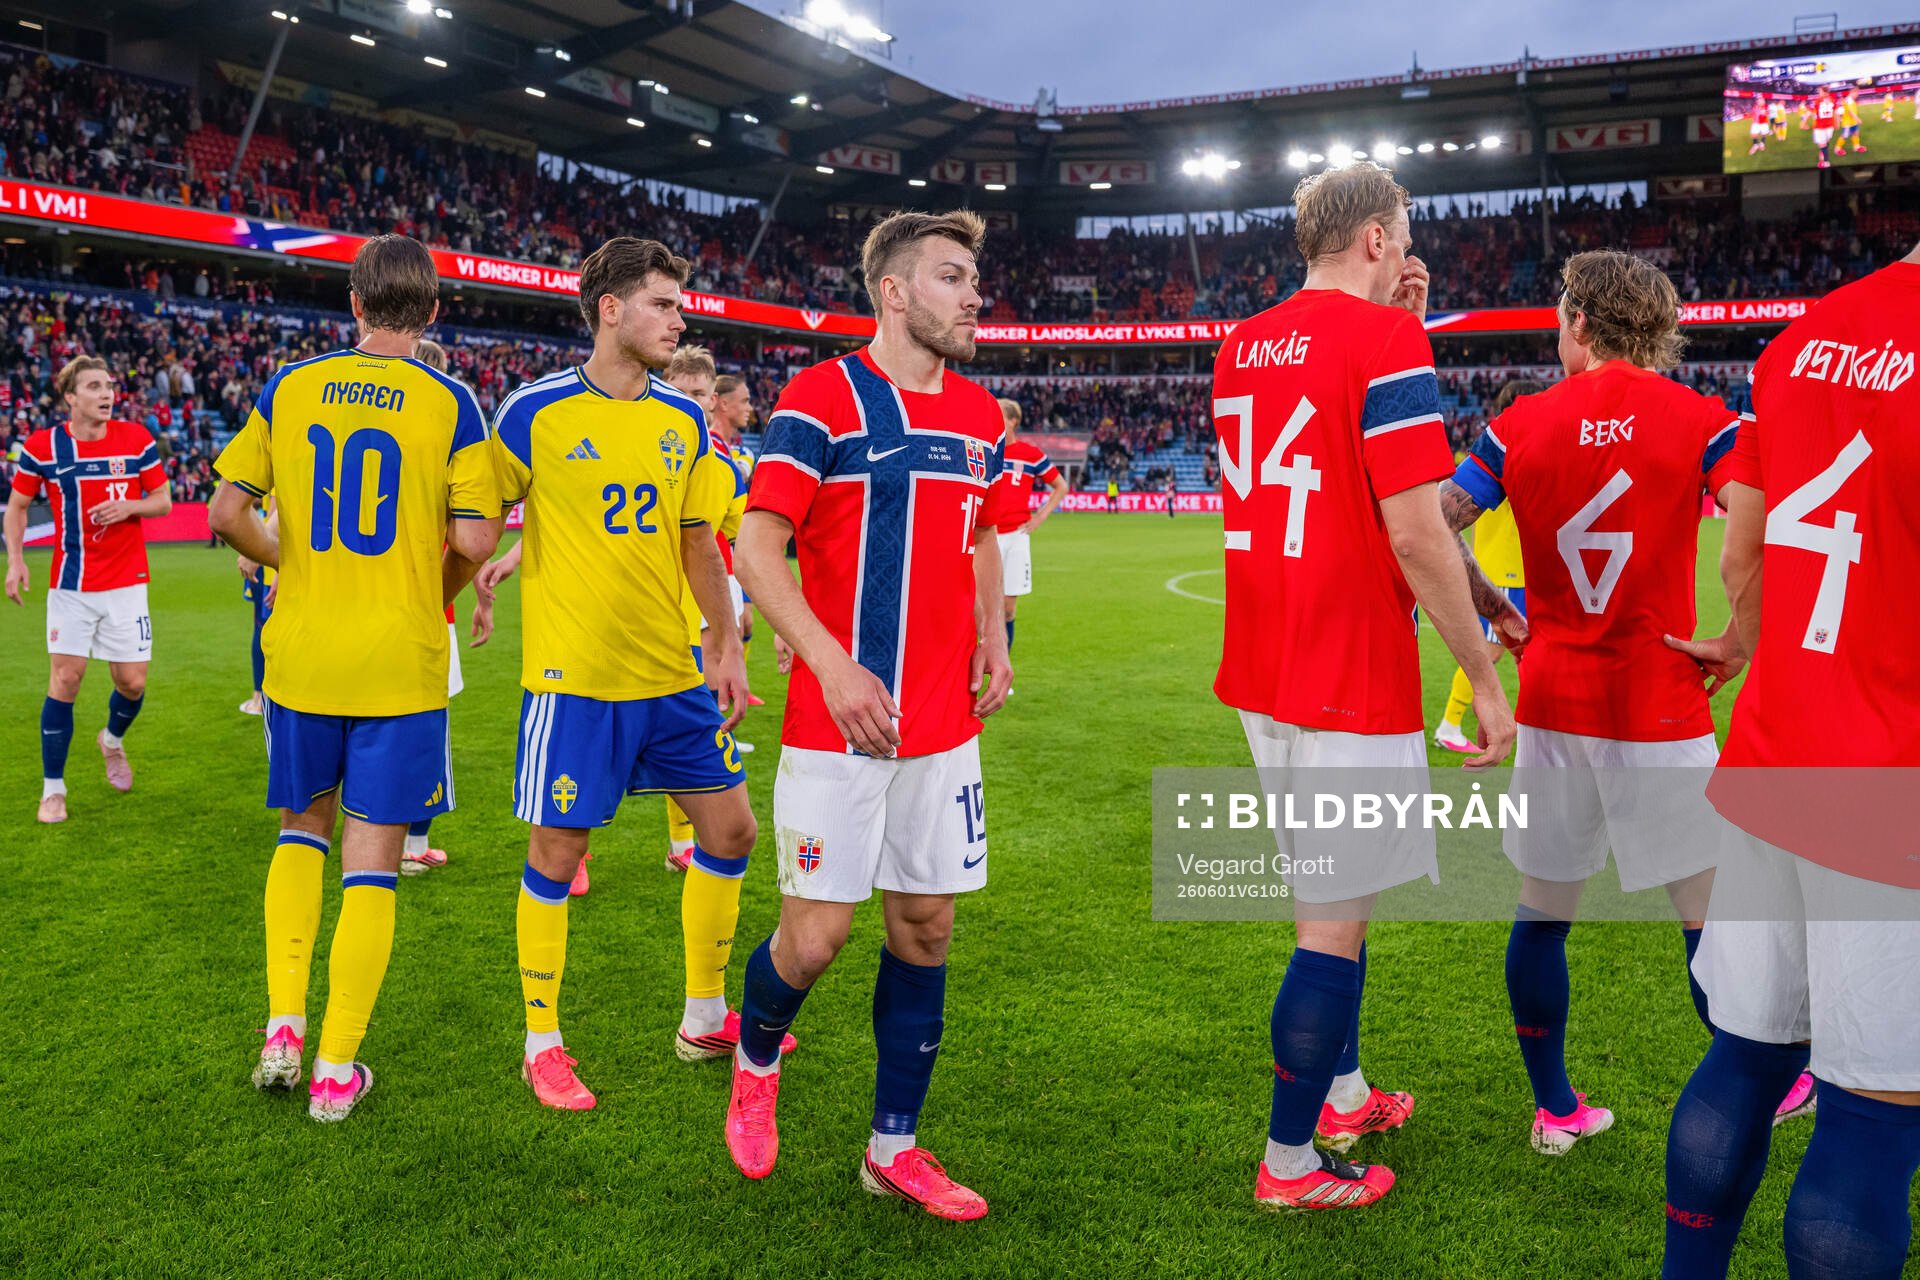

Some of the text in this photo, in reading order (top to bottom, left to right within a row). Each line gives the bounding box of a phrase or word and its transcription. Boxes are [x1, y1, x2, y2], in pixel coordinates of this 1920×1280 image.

[1560, 122, 1648, 148] VG
[832, 148, 892, 171] VG
[1071, 162, 1147, 183] VG
[19, 188, 26, 210] I
[34, 190, 87, 219] VM!
[456, 257, 474, 276] VI
[477, 261, 541, 286] ØNSKER
[696, 297, 701, 310] I
[702, 298, 724, 314] VM!
[975, 328, 1027, 340] NSKER
[1031, 327, 1134, 341] LANDSLAGET
[1136, 325, 1185, 340] LYKKE
[1189, 325, 1212, 338] TIL
[1214, 324, 1220, 337] I
[1235, 330, 1311, 369] LANGÅS
[1789, 338, 1915, 392] ØSTIGÅRD
[321, 381, 405, 413] NYGREN
[1579, 414, 1636, 447] BERG
[307, 423, 402, 556] 10
[1213, 394, 1322, 559] 24
[602, 483, 658, 535] 22
[1145, 496, 1200, 510] LYKE
[1556, 467, 1634, 615] 6
[1763, 428, 1874, 655] 4
[520, 966, 556, 981] SVERIGE
